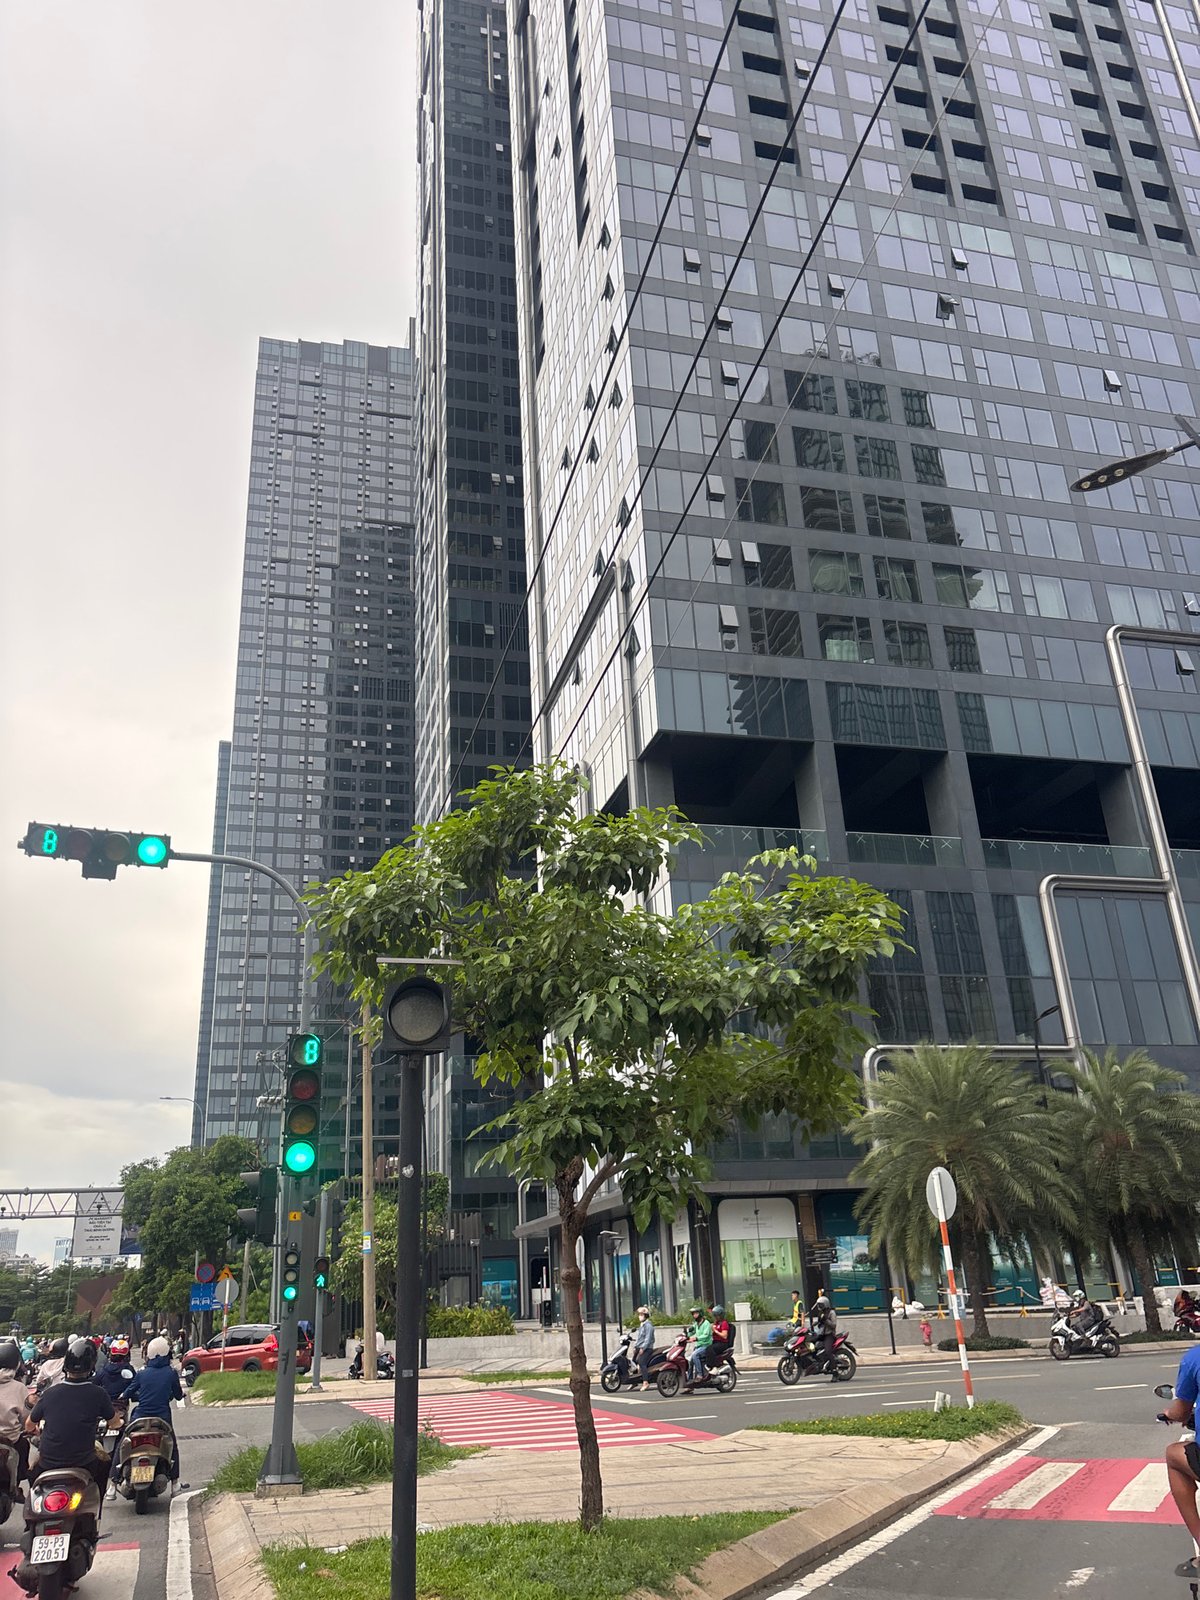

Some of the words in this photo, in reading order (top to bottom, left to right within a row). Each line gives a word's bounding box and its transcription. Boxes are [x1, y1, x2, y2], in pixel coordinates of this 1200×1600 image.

[43, 829, 58, 854] 8
[305, 1039, 318, 1064] 8
[38, 1536, 65, 1549] 59-P3
[34, 1548, 65, 1562] 220.51
